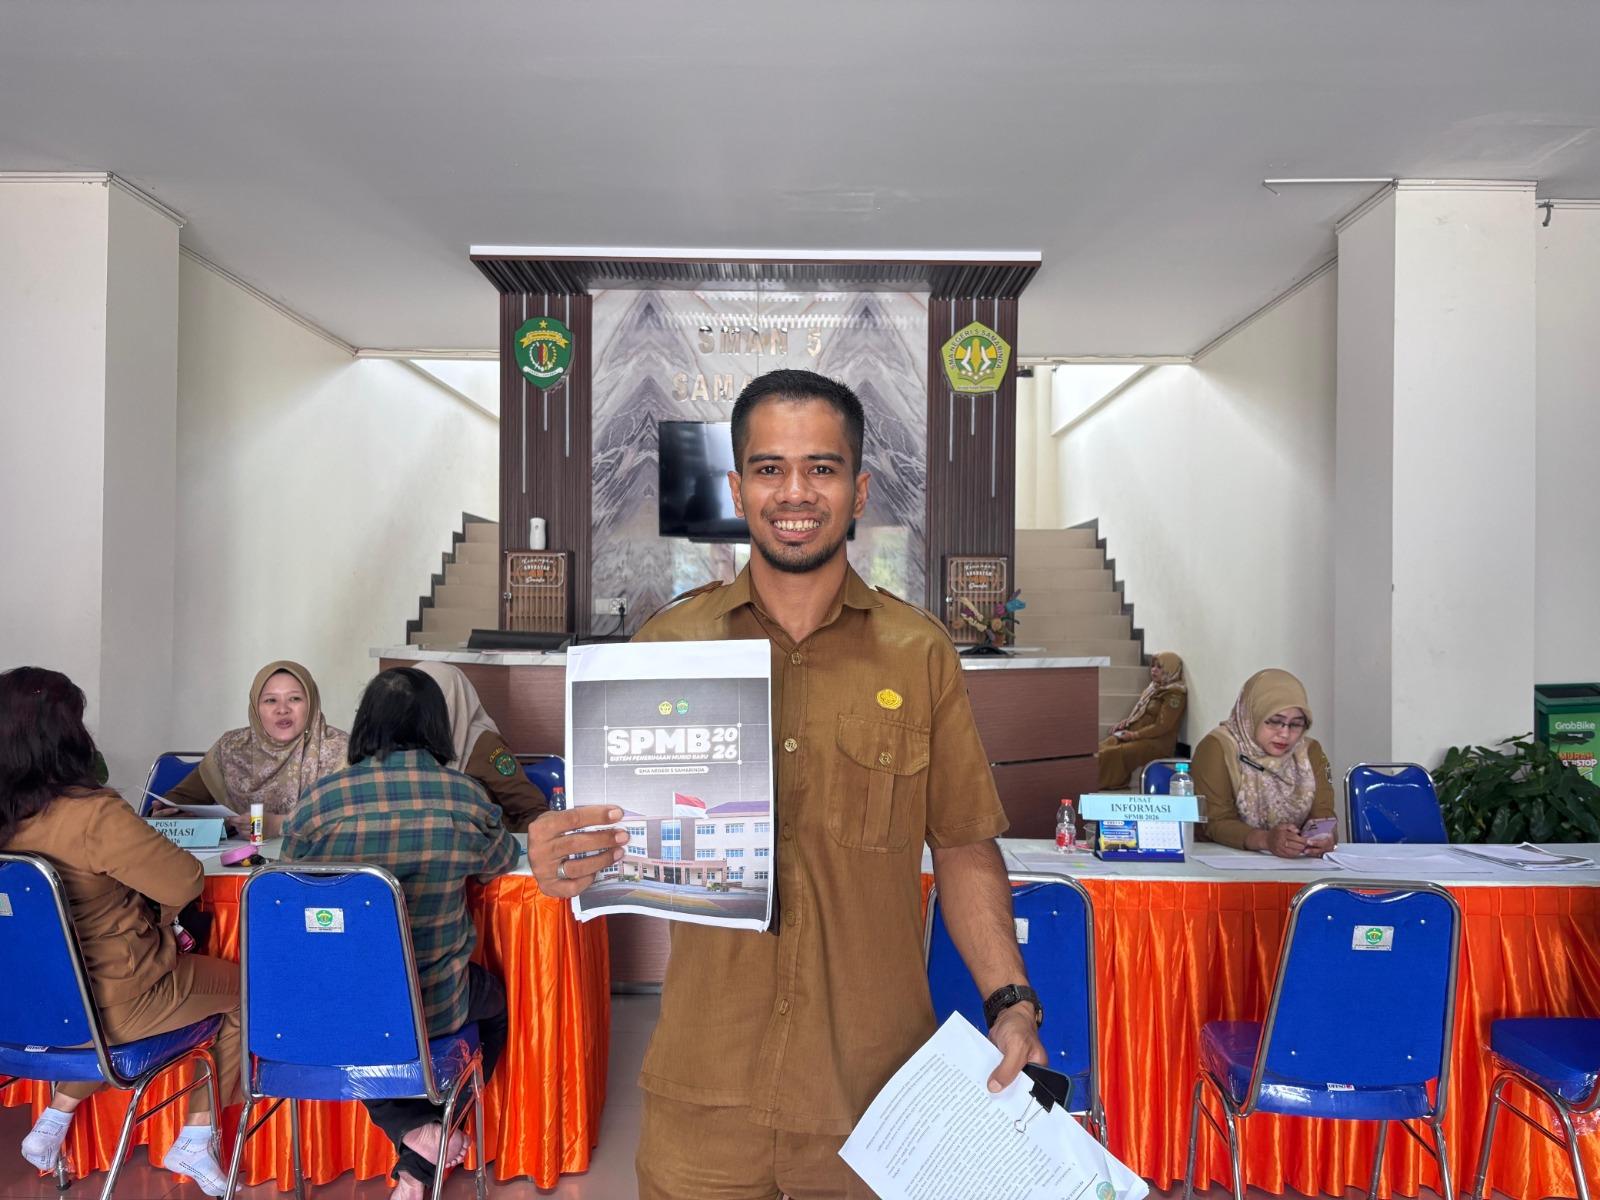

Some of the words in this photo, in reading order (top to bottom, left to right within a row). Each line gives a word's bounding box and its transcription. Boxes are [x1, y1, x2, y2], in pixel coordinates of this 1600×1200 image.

[698, 325, 788, 356] SMAN
[807, 328, 822, 358] 5
[1555, 721, 1596, 730] GrabBike
[607, 728, 711, 755] SPMB
[712, 727, 738, 743] 20
[712, 744, 738, 760] 26
[1111, 804, 1171, 813] INFORMASI
